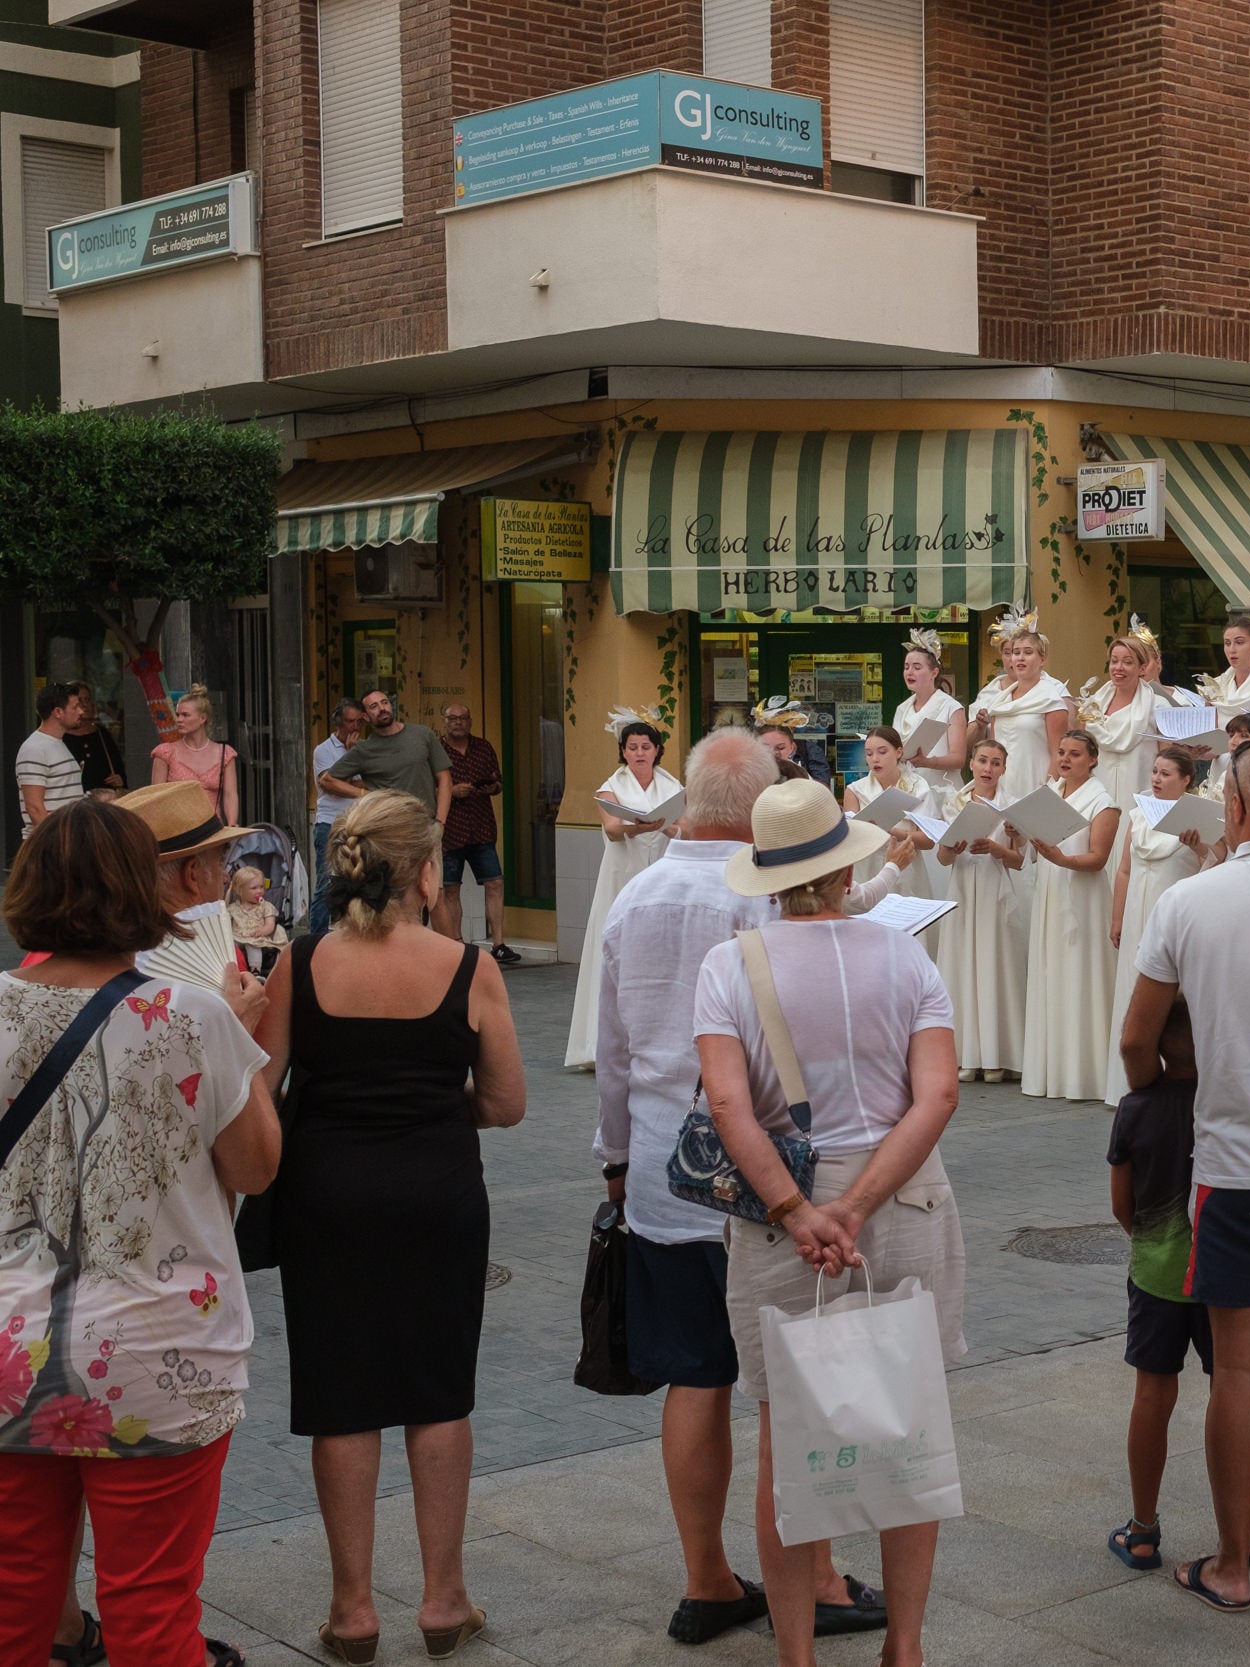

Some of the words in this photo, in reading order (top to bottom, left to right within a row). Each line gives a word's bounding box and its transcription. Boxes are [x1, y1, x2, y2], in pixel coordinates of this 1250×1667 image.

[467, 123, 503, 141] Conveyancing
[502, 119, 527, 134] Purchase
[532, 114, 544, 125] Sale
[548, 110, 564, 122] Taxes
[567, 102, 588, 118] Spanish
[588, 100, 603, 111] Wills
[607, 93, 639, 107] Inheritance
[714, 104, 811, 141] consulting
[468, 150, 497, 166] Begeleiding
[525, 139, 548, 152] verkoop
[552, 132, 582, 146] Belastingen
[587, 125, 615, 138] Testament
[619, 118, 640, 129] Erfenis
[470, 178, 506, 192] Asesoramiento
[506, 173, 526, 186] compra
[531, 168, 546, 177] venta
[550, 161, 578, 174] Impuestos
[582, 152, 618, 166] Testamentos
[621, 144, 650, 158] Herencias
[676, 152, 690, 162] TLF:
[691, 155, 704, 165] +34
[705, 157, 716, 166] 691
[717, 159, 729, 168] 774
[730, 160, 740, 170] 288
[159, 217, 174, 230] TLF:
[174, 211, 188, 226] +34
[188, 208, 200, 224] 691
[202, 205, 214, 220] 774
[214, 202, 227, 217] 288
[79, 224, 137, 254] consulting
[152, 244, 169, 256] Email:
[1080, 468, 1102, 476] ALIMENTOS
[1103, 466, 1126, 474] NATURALES
[511, 502, 530, 519] Casa
[533, 504, 542, 519] de
[545, 504, 556, 520] las
[636, 514, 671, 554] La
[684, 514, 749, 554] Casa
[763, 516, 792, 553] de
[806, 516, 846, 553] las
[1106, 522, 1149, 536] DIETETICA
[503, 534, 542, 545] Productos
[534, 548, 546, 557] de
[550, 549, 584, 558] Belleza
[502, 557, 544, 568] Masajes
